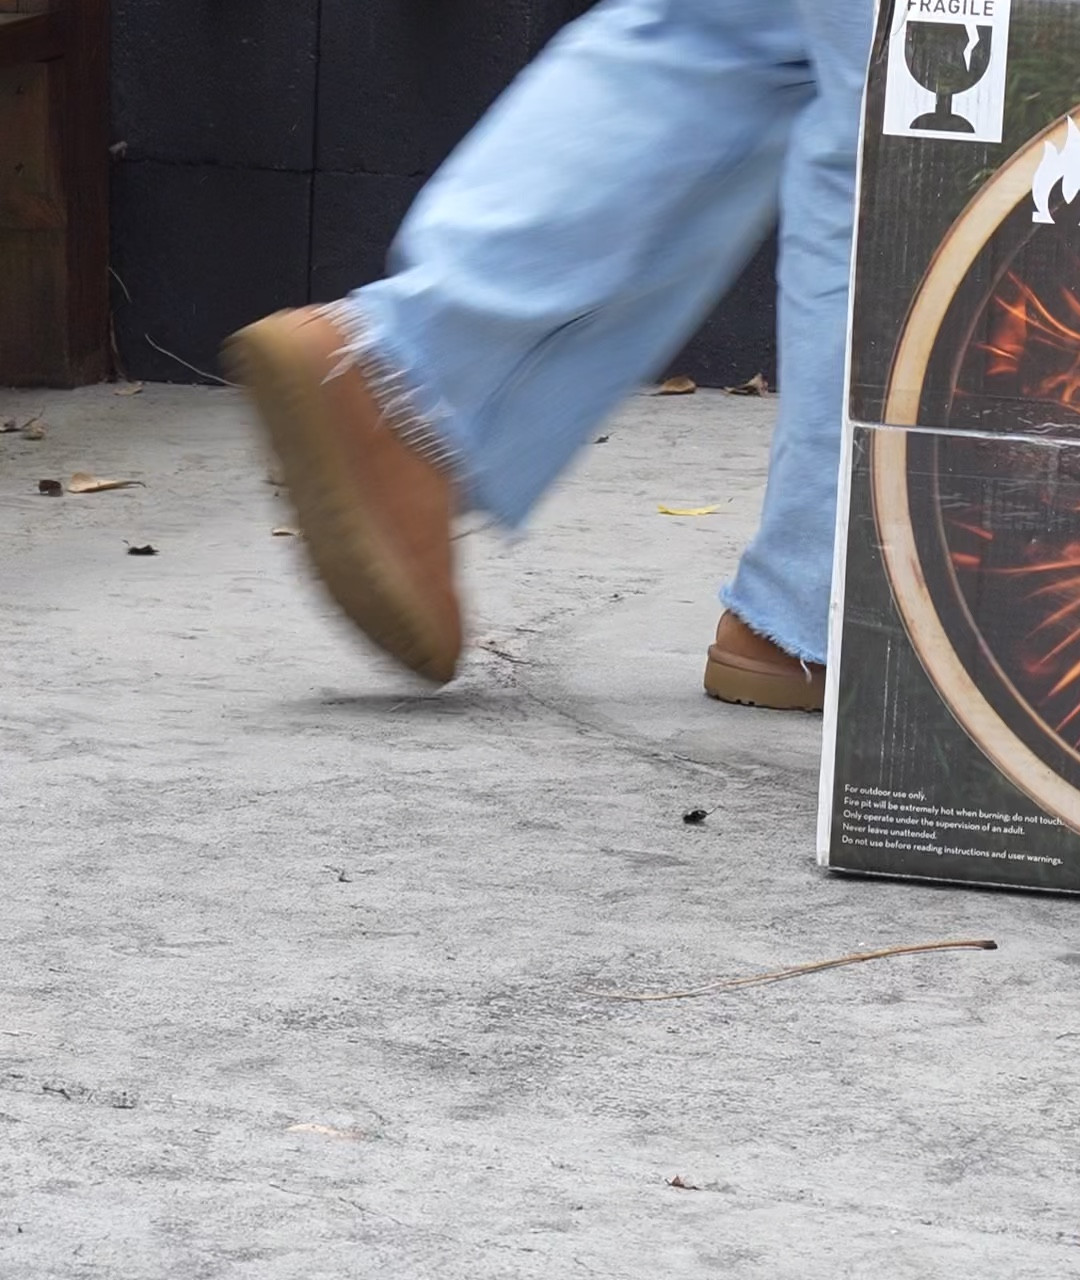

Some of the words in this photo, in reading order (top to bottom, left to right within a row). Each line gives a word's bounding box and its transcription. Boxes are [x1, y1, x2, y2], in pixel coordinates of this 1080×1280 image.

[845, 784, 859, 793] For
[860, 787, 891, 797] outdoor
[892, 791, 907, 799] use
[908, 792, 928, 802] only.
[843, 810, 862, 821] Only
[863, 814, 895, 823] operate
[896, 816, 919, 825] under
[921, 818, 934, 827] the
[936, 821, 980, 831] supervision
[982, 823, 990, 832] of
[1003, 826, 1025, 835] adult.
[844, 797, 860, 806] Fire
[861, 800, 872, 809] pit
[873, 801, 887, 809] will
[888, 802, 899, 810] be
[900, 805, 939, 816] extremely
[941, 806, 954, 816] hot
[956, 808, 977, 818] when
[1025, 815, 1038, 824] not
[842, 823, 866, 833] Never
[868, 825, 889, 835] leave
[890, 829, 937, 840] unattended.
[842, 835, 853, 844] Do
[855, 838, 868, 847] not
[870, 840, 884, 848] use
[885, 840, 912, 850] before
[913, 843, 943, 856] reading
[944, 846, 990, 857] instructions
[991, 850, 1006, 859] and
[1008, 852, 1025, 860] user
[1027, 854, 1064, 866] warnings.
